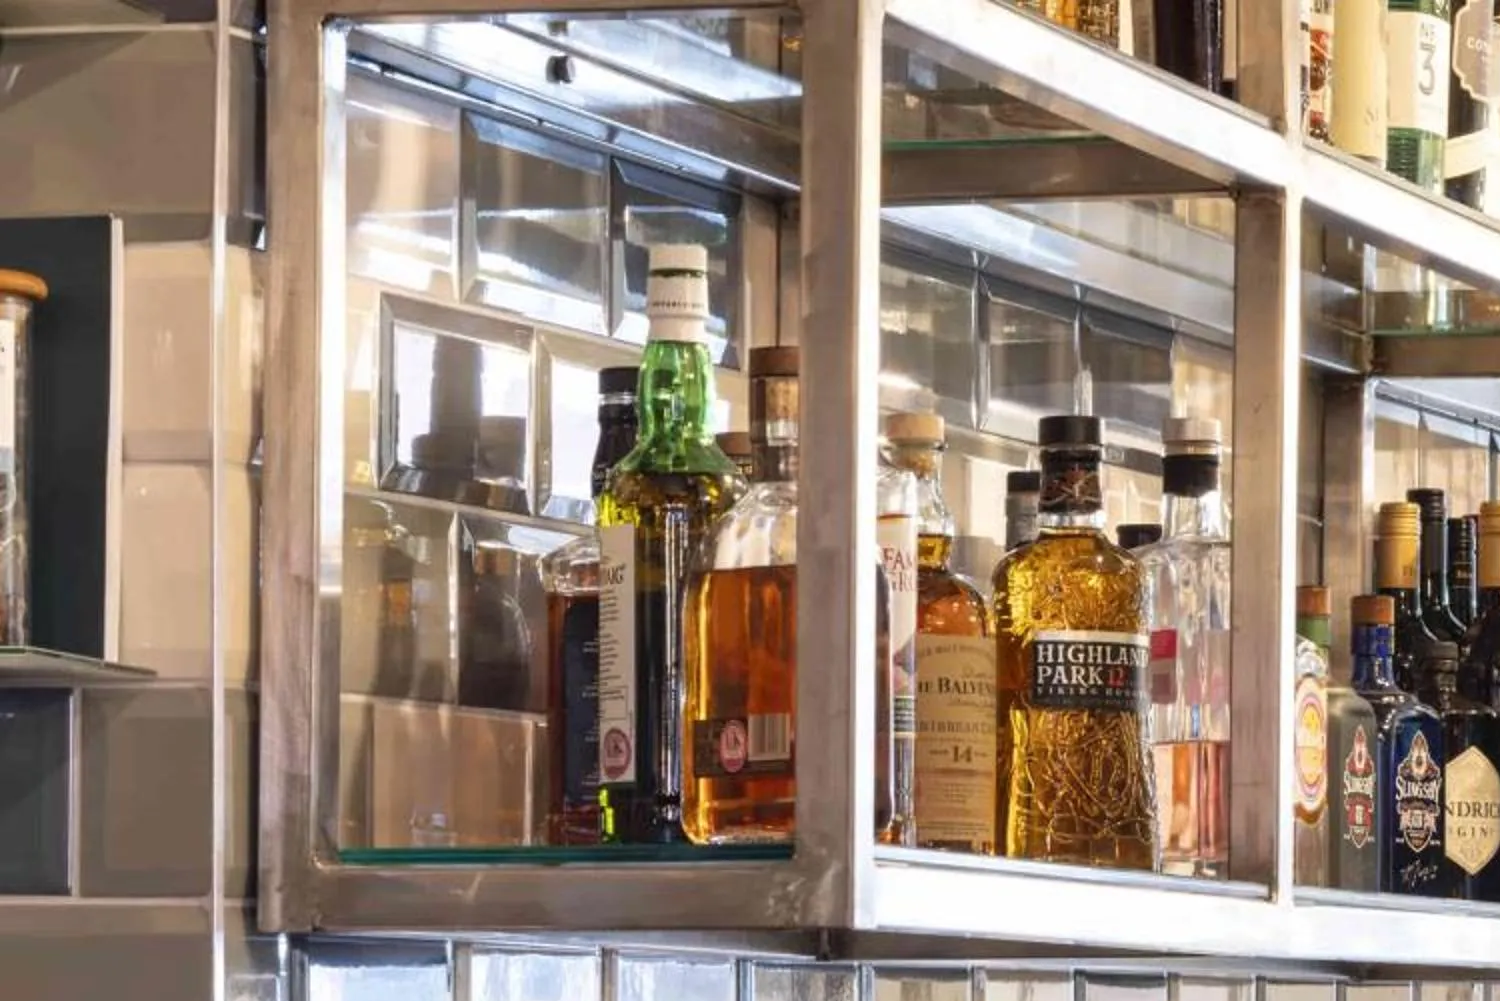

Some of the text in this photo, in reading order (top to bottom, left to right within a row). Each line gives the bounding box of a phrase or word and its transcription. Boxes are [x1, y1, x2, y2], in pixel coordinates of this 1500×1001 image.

[1418, 53, 1436, 96] 3
[1036, 643, 1149, 669] HIGHLAND
[1036, 665, 1104, 687] PARK
